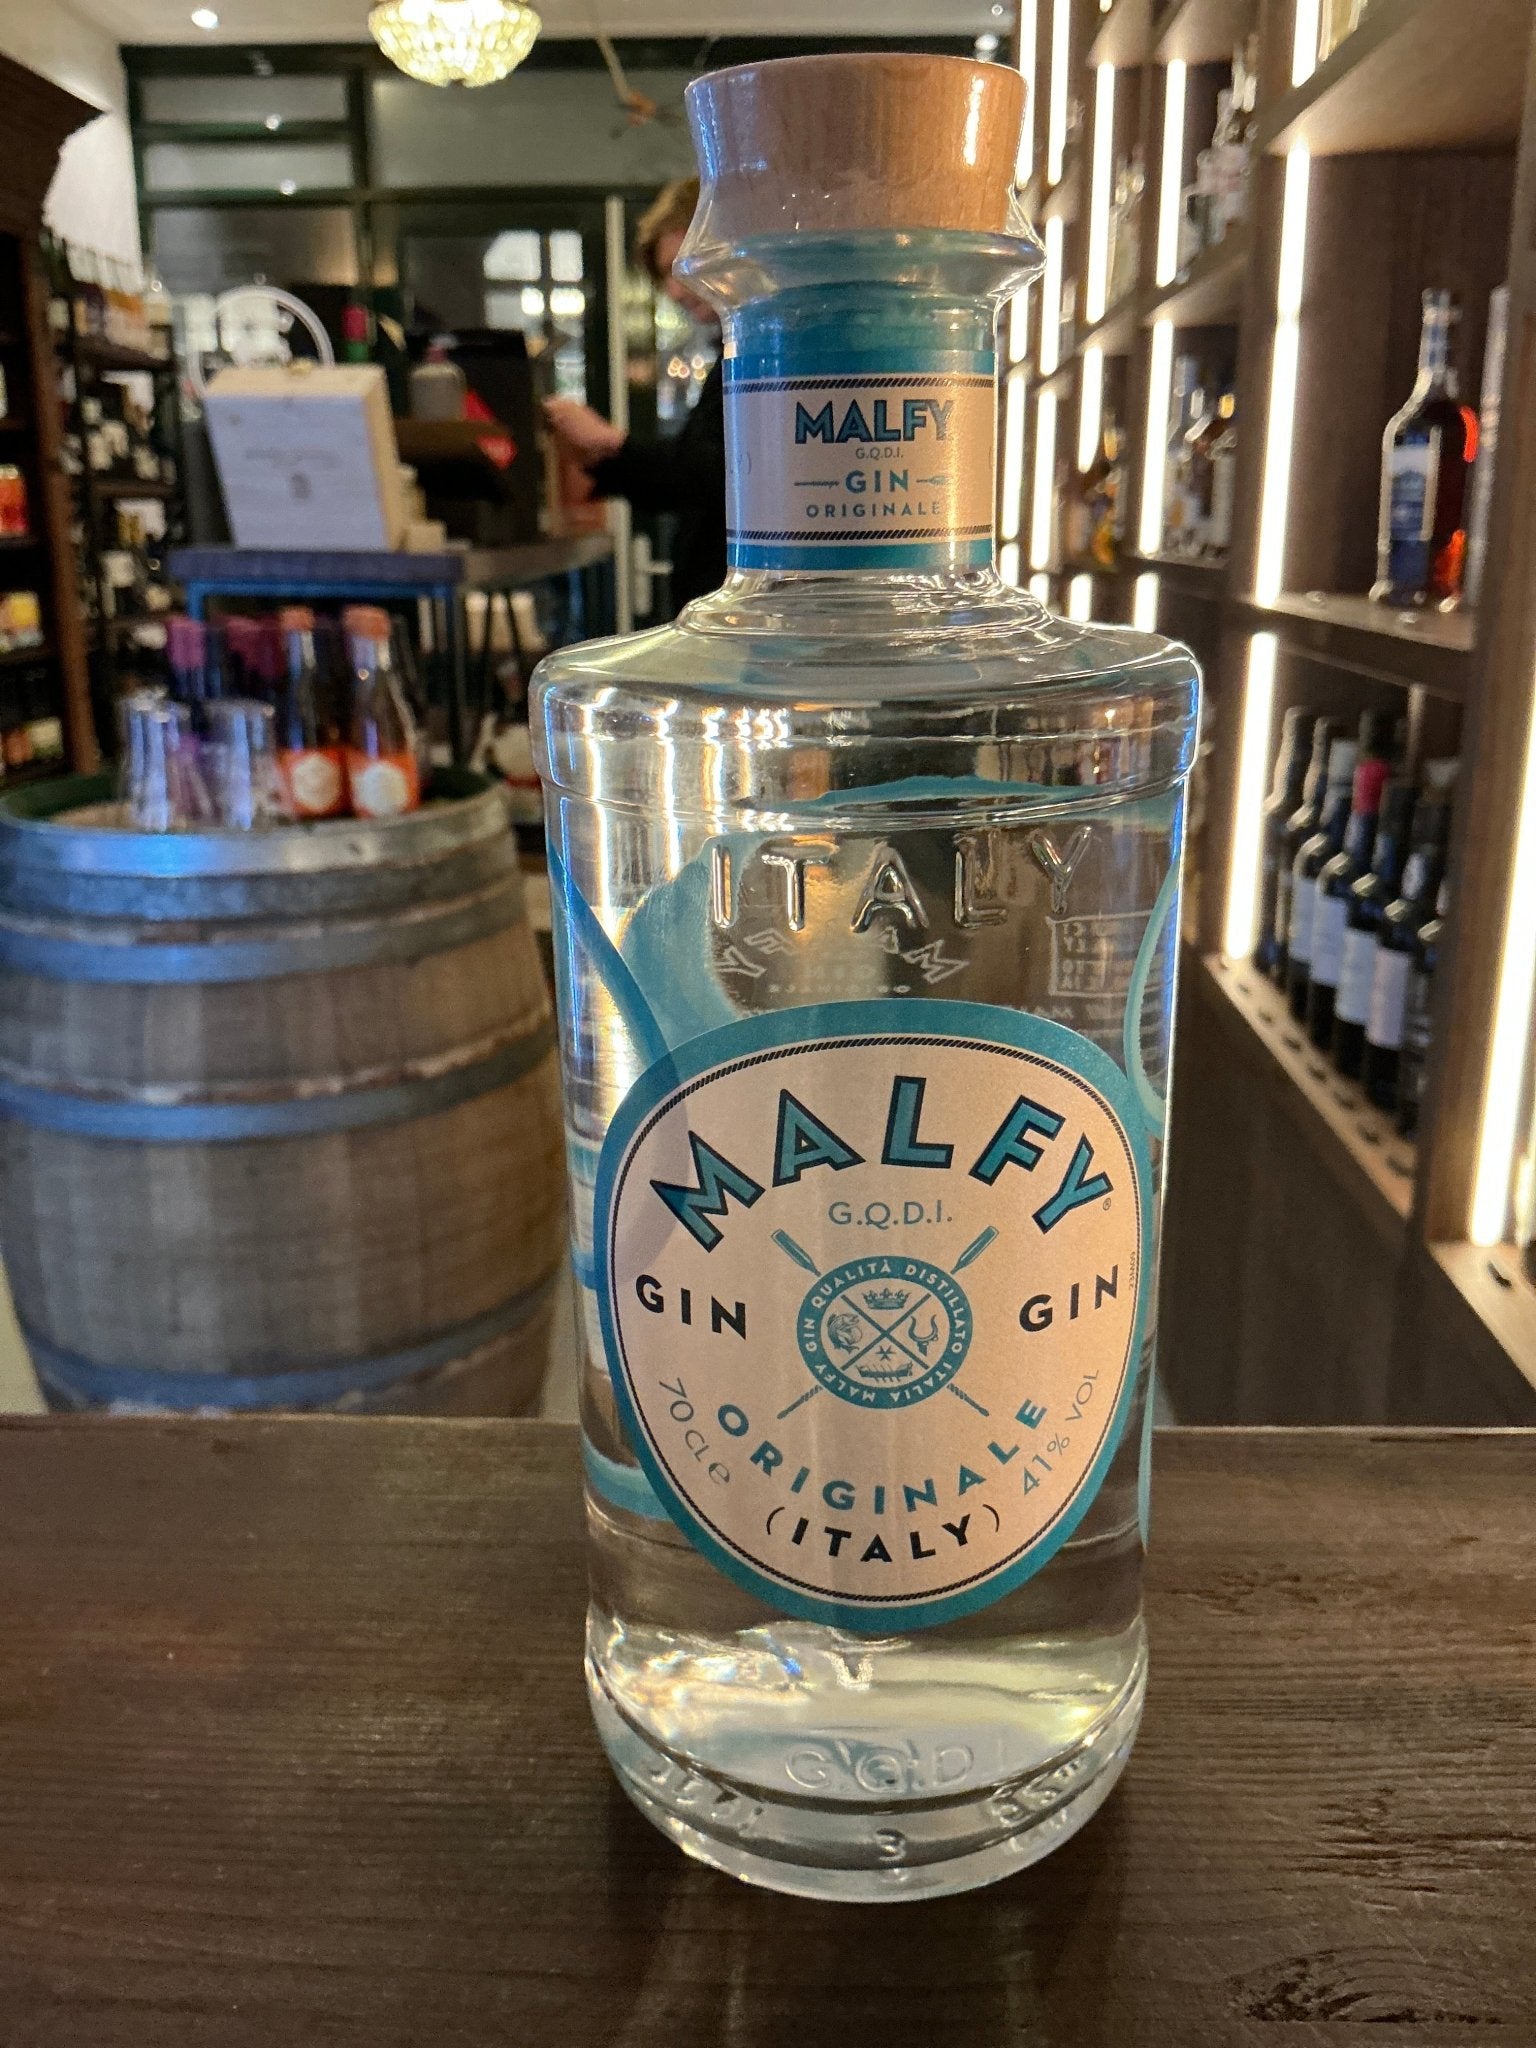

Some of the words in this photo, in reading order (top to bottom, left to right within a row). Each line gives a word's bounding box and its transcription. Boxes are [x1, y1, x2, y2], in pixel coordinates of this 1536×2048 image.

[795, 399, 954, 444] MALFY
[845, 469, 909, 494] GIN
[806, 501, 941, 518] ORIGINALE
[711, 825, 1093, 932] ITALY
[650, 1075, 1114, 1253] MALFY
[829, 1200, 953, 1229] G.Q.D.I.
[635, 1274, 747, 1339] GIN
[811, 1259, 893, 1309] QUALITÀ
[905, 1264, 967, 1355] DISTILLATO
[1019, 1264, 1119, 1332] GIN
[803, 1318, 818, 1353] GIN
[815, 1363, 877, 1403] MALFY
[889, 1362, 953, 1402] ITALIA
[718, 1399, 1048, 1515] ORIGINALE
[1023, 1433, 1070, 1495] 41%
[1064, 1369, 1099, 1421] VOL
[766, 1504, 1000, 1563] (ITALY)
